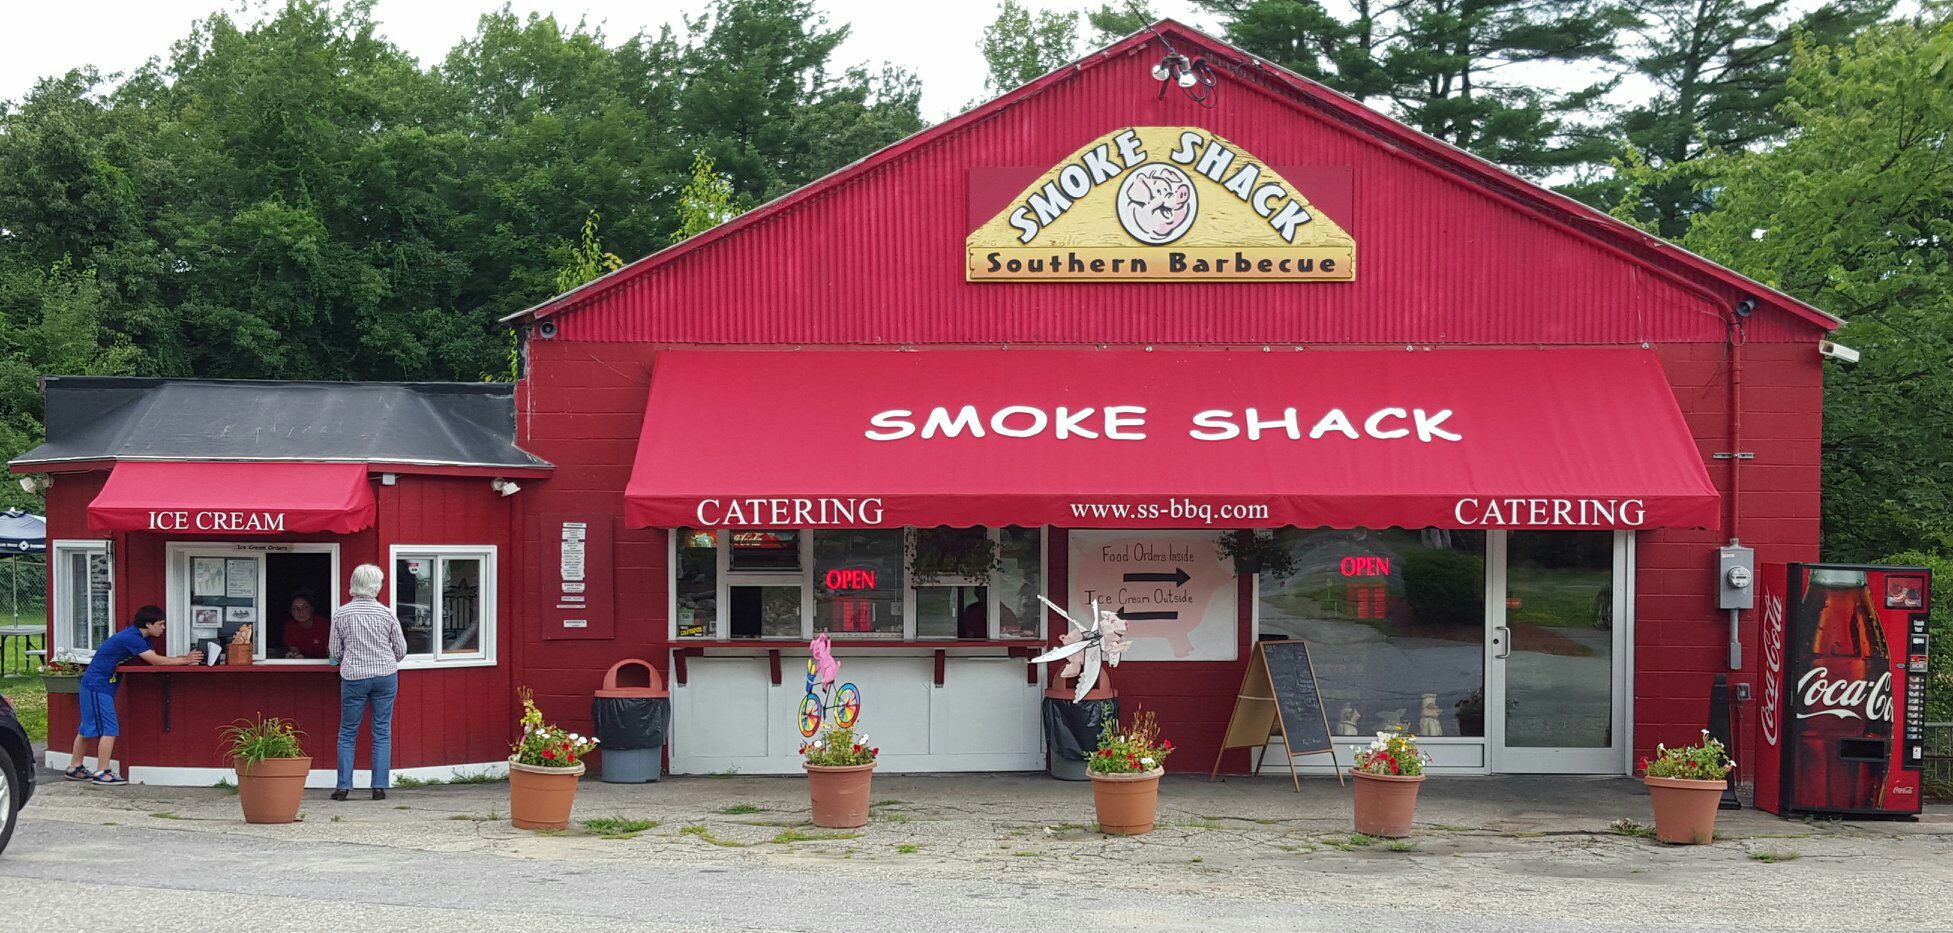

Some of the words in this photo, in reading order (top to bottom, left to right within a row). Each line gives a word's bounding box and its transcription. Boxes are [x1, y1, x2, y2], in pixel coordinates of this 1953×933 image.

[1008, 127, 1148, 245] SMOKE
[1170, 131, 1312, 245] SHACK
[986, 252, 1148, 274] Southern
[1168, 252, 1337, 274] Barbecue
[864, 405, 1147, 441] SMOKE
[1189, 407, 1463, 442] SHACK
[148, 511, 189, 530] ICE
[195, 511, 285, 531] CREAM
[696, 498, 884, 526] CATERING
[1070, 498, 1269, 524] www.ss-bbq.com
[1454, 498, 1647, 526] CATERING
[1102, 544, 1129, 563] Food
[1133, 542, 1167, 563] Orders
[1169, 543, 1195, 563] Inside
[1339, 555, 1391, 577] OPEN
[825, 569, 876, 590] OPEN
[1084, 589, 1112, 606] Ice
[1118, 587, 1150, 604] Cream
[1153, 588, 1193, 604] Outside
